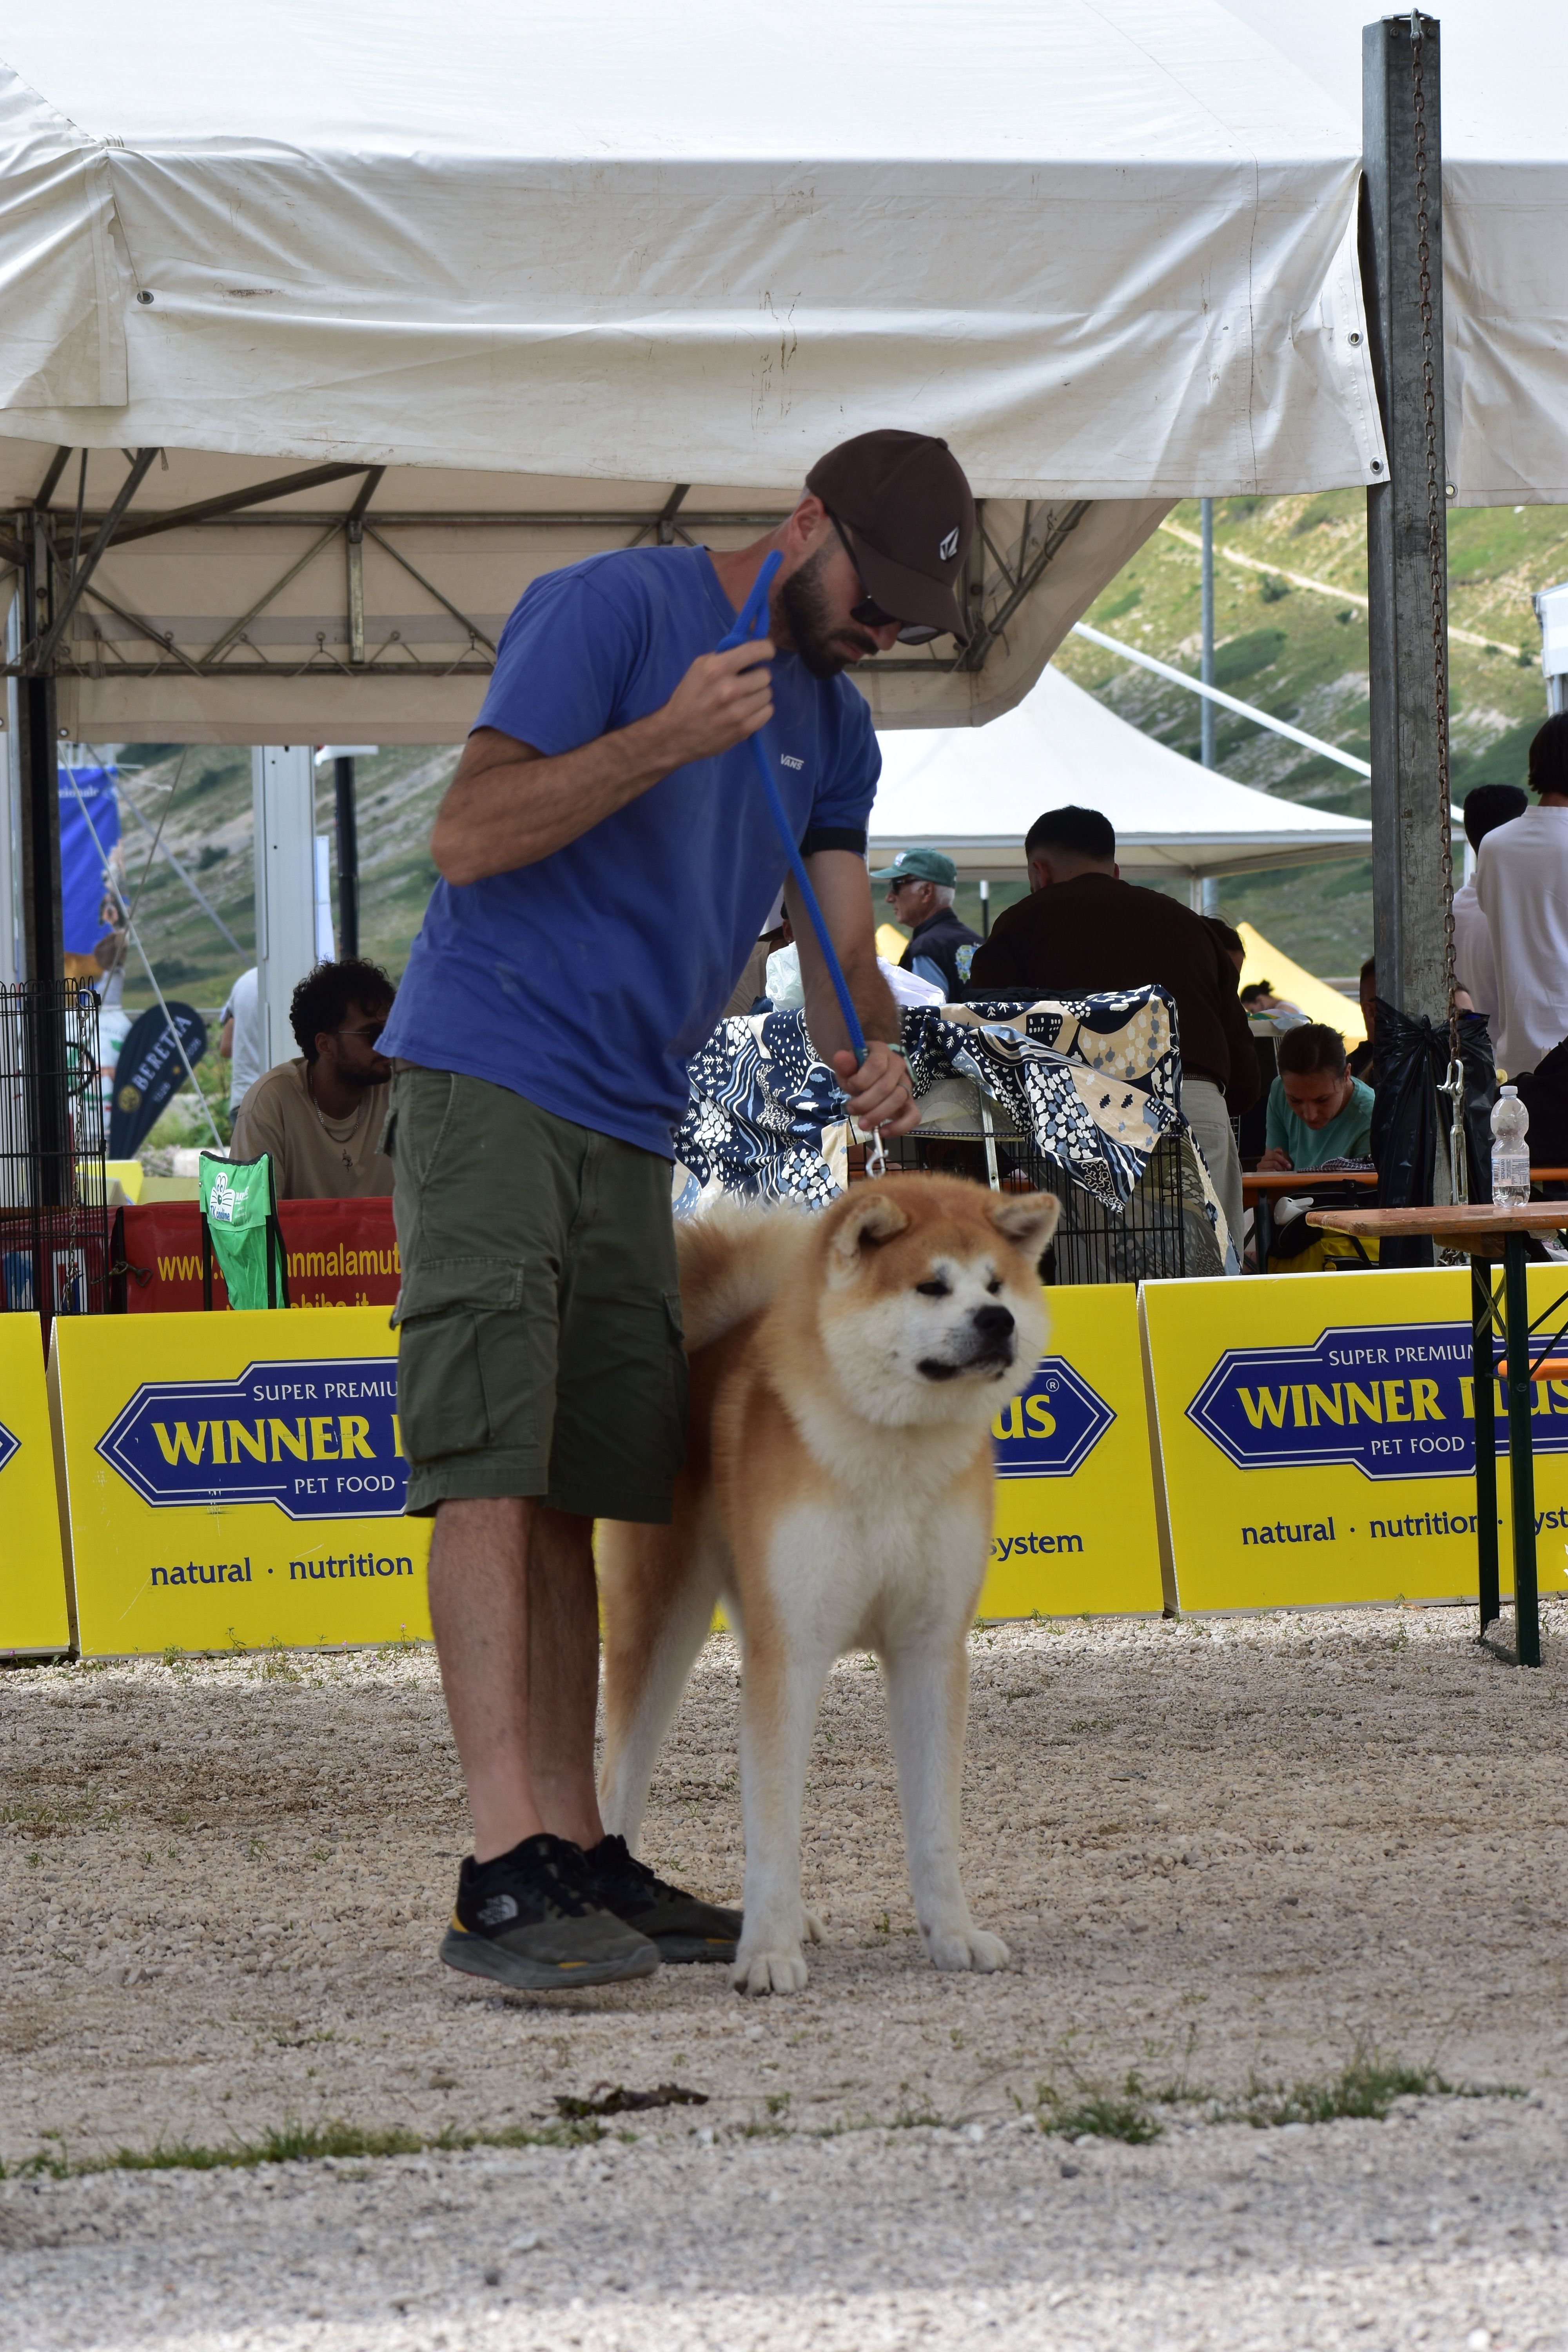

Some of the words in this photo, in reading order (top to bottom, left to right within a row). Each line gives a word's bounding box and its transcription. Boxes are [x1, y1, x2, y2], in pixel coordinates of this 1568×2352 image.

[781, 753, 804, 770] VANS
[1329, 1348, 1390, 1366] SUPER
[253, 1384, 318, 1401] SUPER
[324, 1381, 398, 1398] PREMIU
[1236, 1378, 1447, 1429] WINNER
[151, 1416, 377, 1466] WINNER
[1371, 1439, 1403, 1455] PET
[1410, 1436, 1465, 1454] FOOD
[294, 1477, 328, 1494] PET
[337, 1475, 395, 1492] FOOD
[1241, 1516, 1336, 1545] natural
[1535, 1506, 1568, 1536] yst
[151, 1557, 252, 1585] natural
[289, 1553, 414, 1579] nutrition
